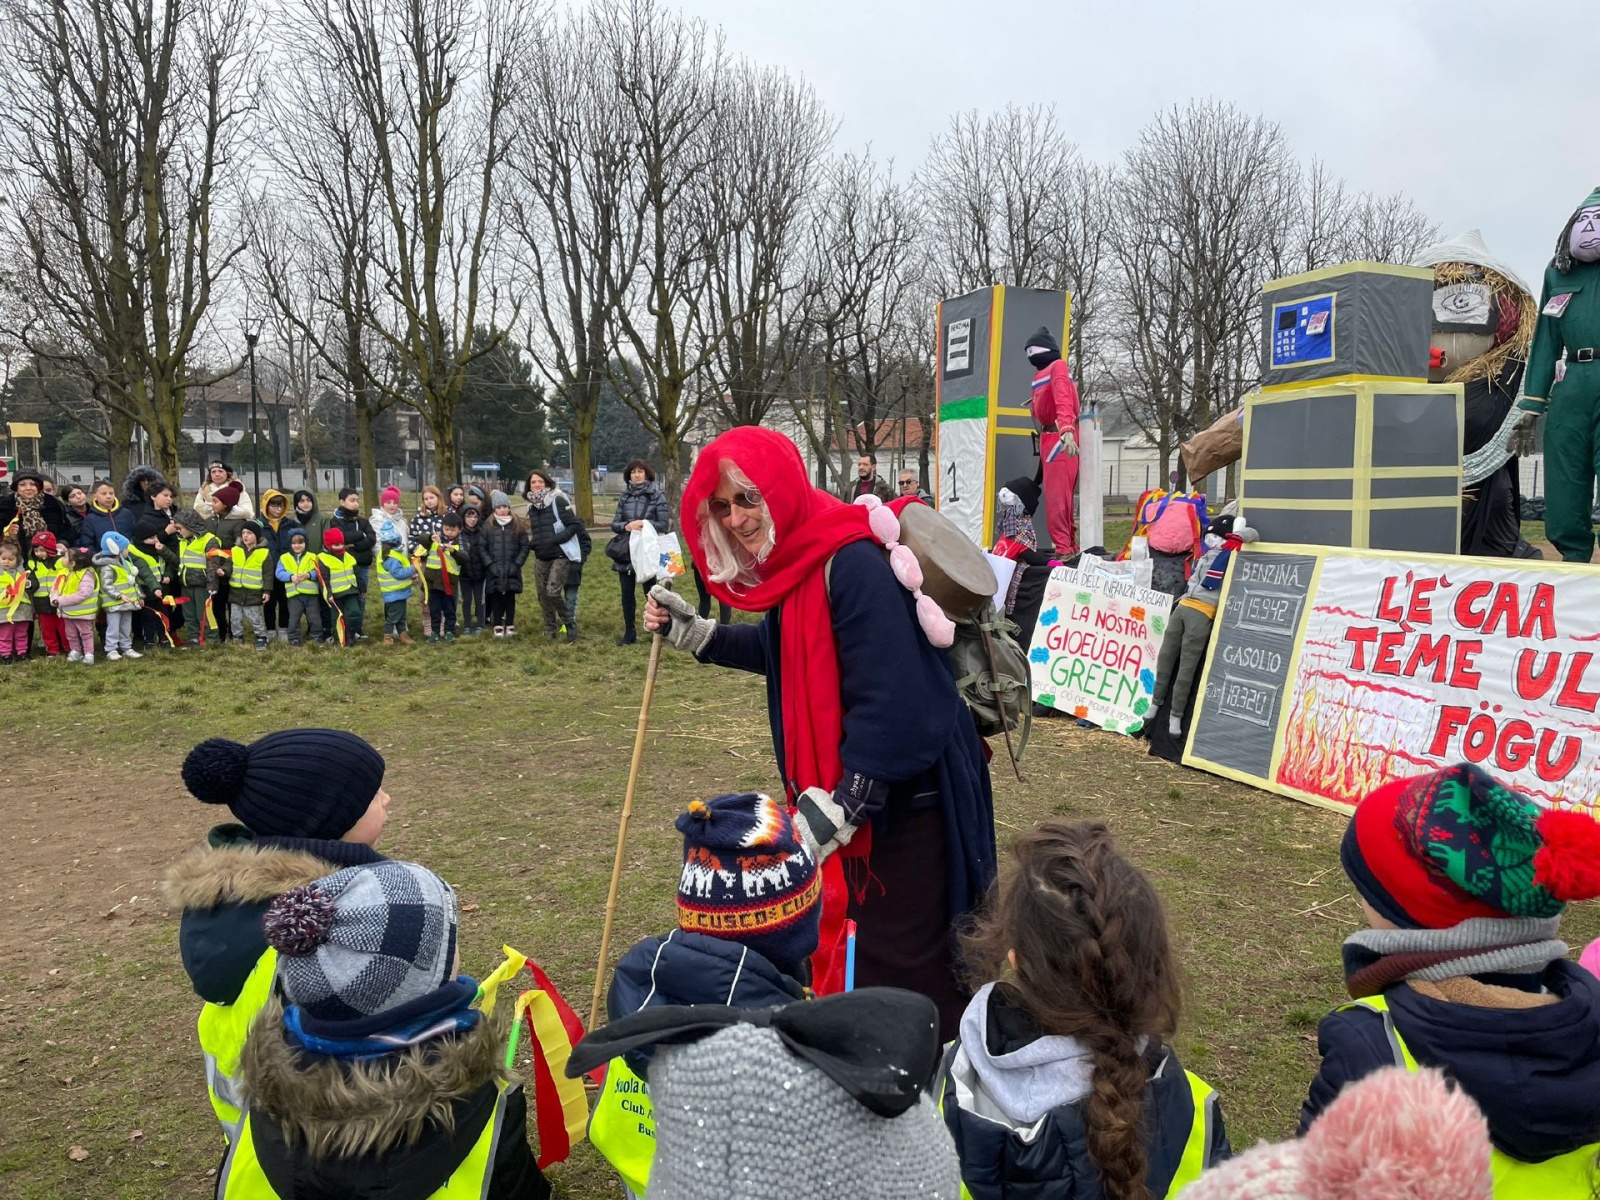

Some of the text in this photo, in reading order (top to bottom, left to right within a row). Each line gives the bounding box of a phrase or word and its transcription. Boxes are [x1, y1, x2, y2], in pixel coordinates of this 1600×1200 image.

[947, 461, 960, 503] 1
[1241, 562, 1305, 588] BENZINA
[1071, 604, 1090, 623] LA
[1094, 609, 1148, 640] NOSTRA
[1246, 597, 1289, 622] 15.942
[1448, 580, 1557, 640] CAA
[1222, 645, 1281, 673] GASOLIO
[1050, 656, 1139, 708] GREEN
[1511, 648, 1600, 713] UL
[1226, 685, 1267, 715] 18.320
[1421, 700, 1582, 782] FÖGU
[621, 1099, 645, 1116] Club
[638, 1122, 656, 1139] Bus
